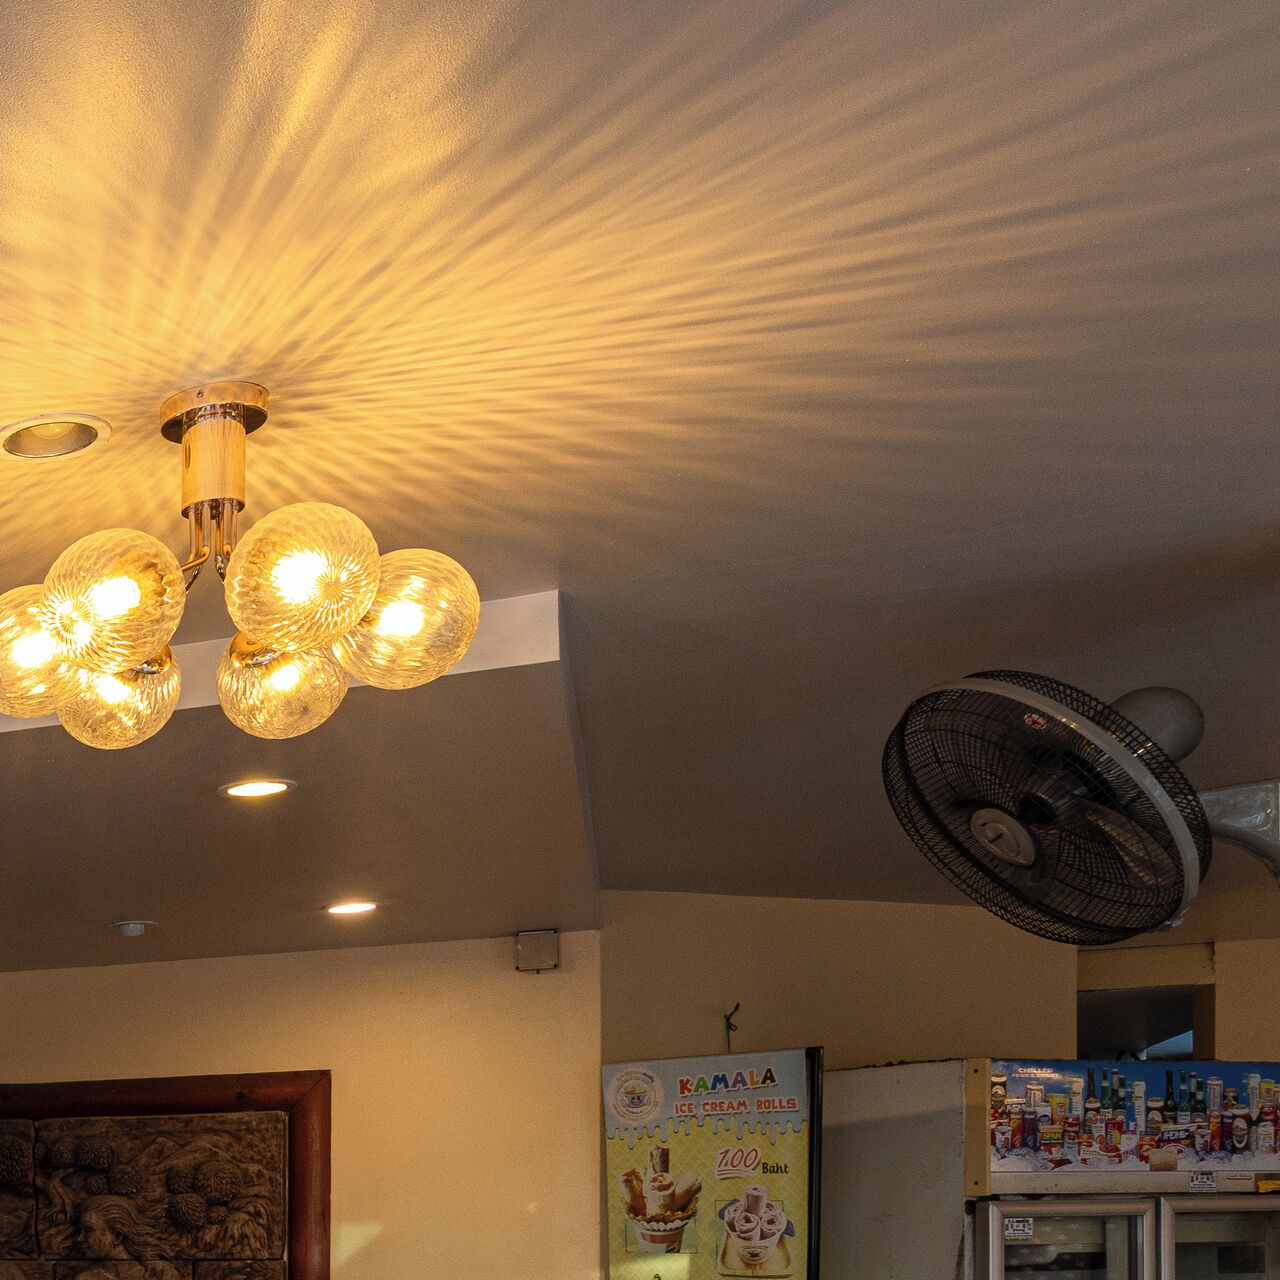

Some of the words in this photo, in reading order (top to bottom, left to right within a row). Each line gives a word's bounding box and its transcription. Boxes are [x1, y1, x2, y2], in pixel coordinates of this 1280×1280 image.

[678, 1066, 779, 1096] KAMALA
[674, 1101, 696, 1115] ICE
[701, 1099, 748, 1113] CREAM
[756, 1097, 798, 1111] ROLLS
[761, 1161, 790, 1176] Baht
